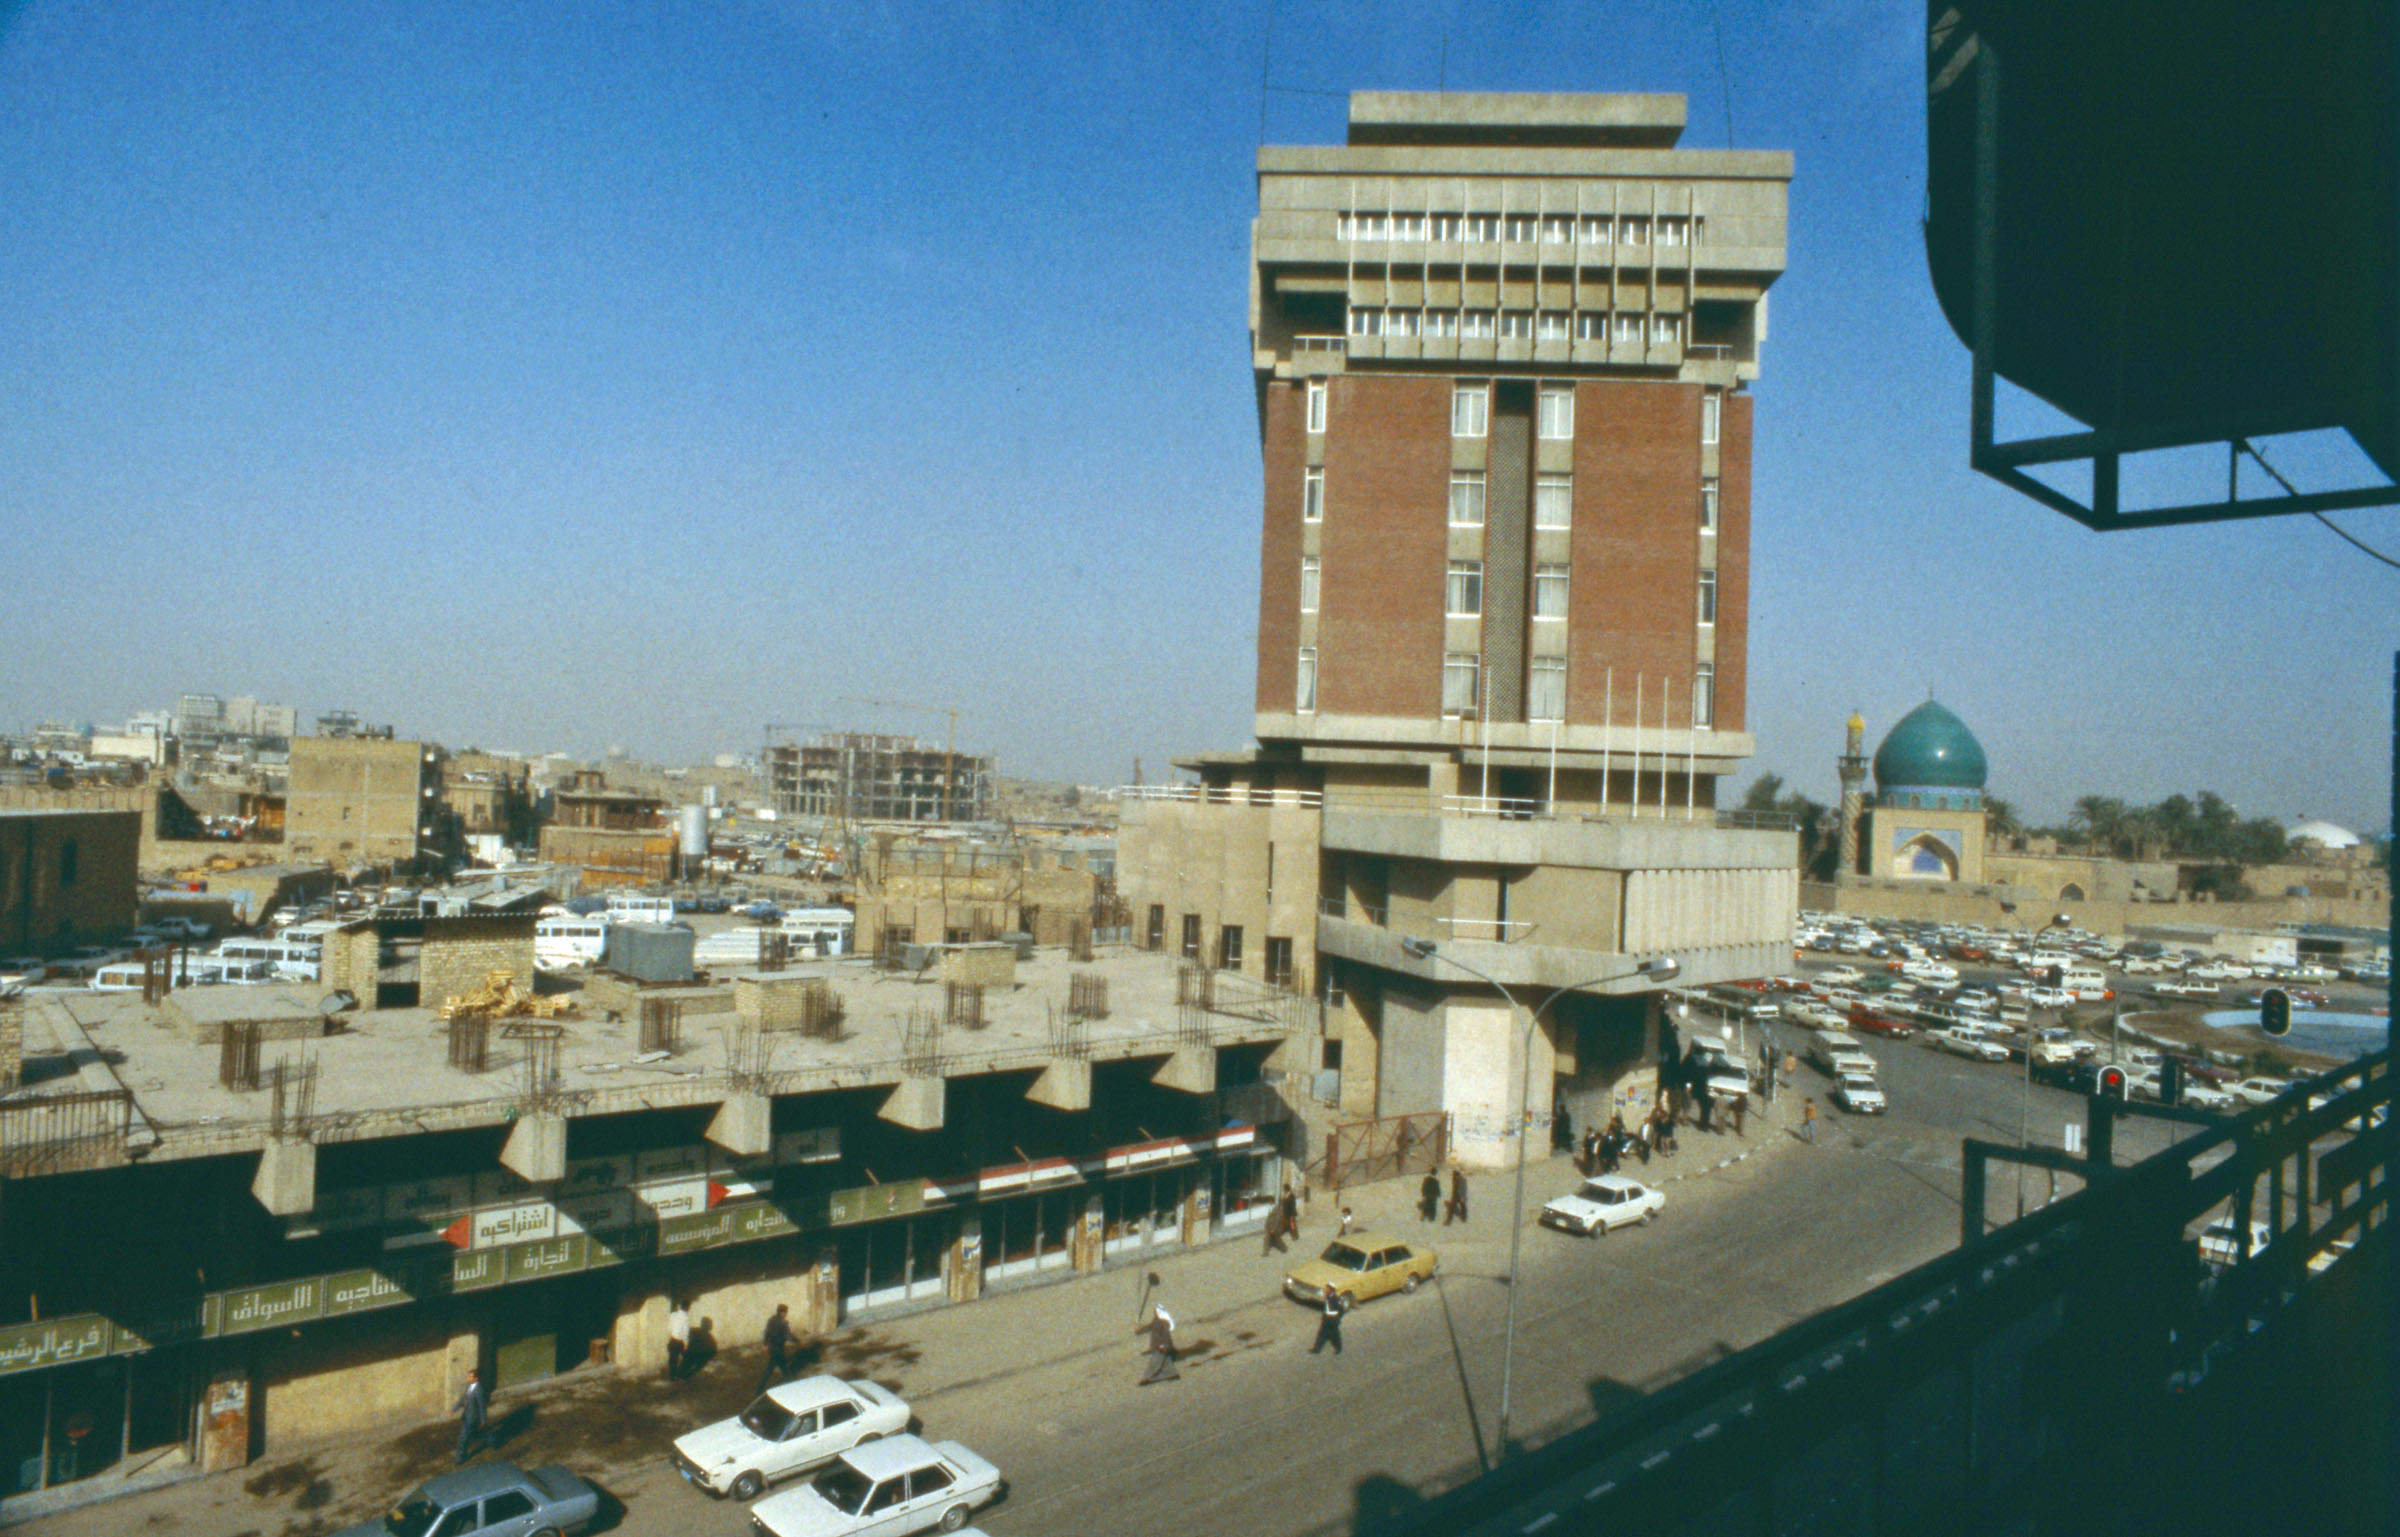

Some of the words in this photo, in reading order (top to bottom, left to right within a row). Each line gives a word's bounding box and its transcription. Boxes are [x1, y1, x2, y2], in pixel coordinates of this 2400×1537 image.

[480, 1206, 549, 1246] اشتراكيه
[523, 1239, 570, 1271] لتجارة
[232, 1284, 313, 1322] الاسواق
[0, 1329, 57, 1367] الرشي
[55, 1323, 101, 1360] فرع
